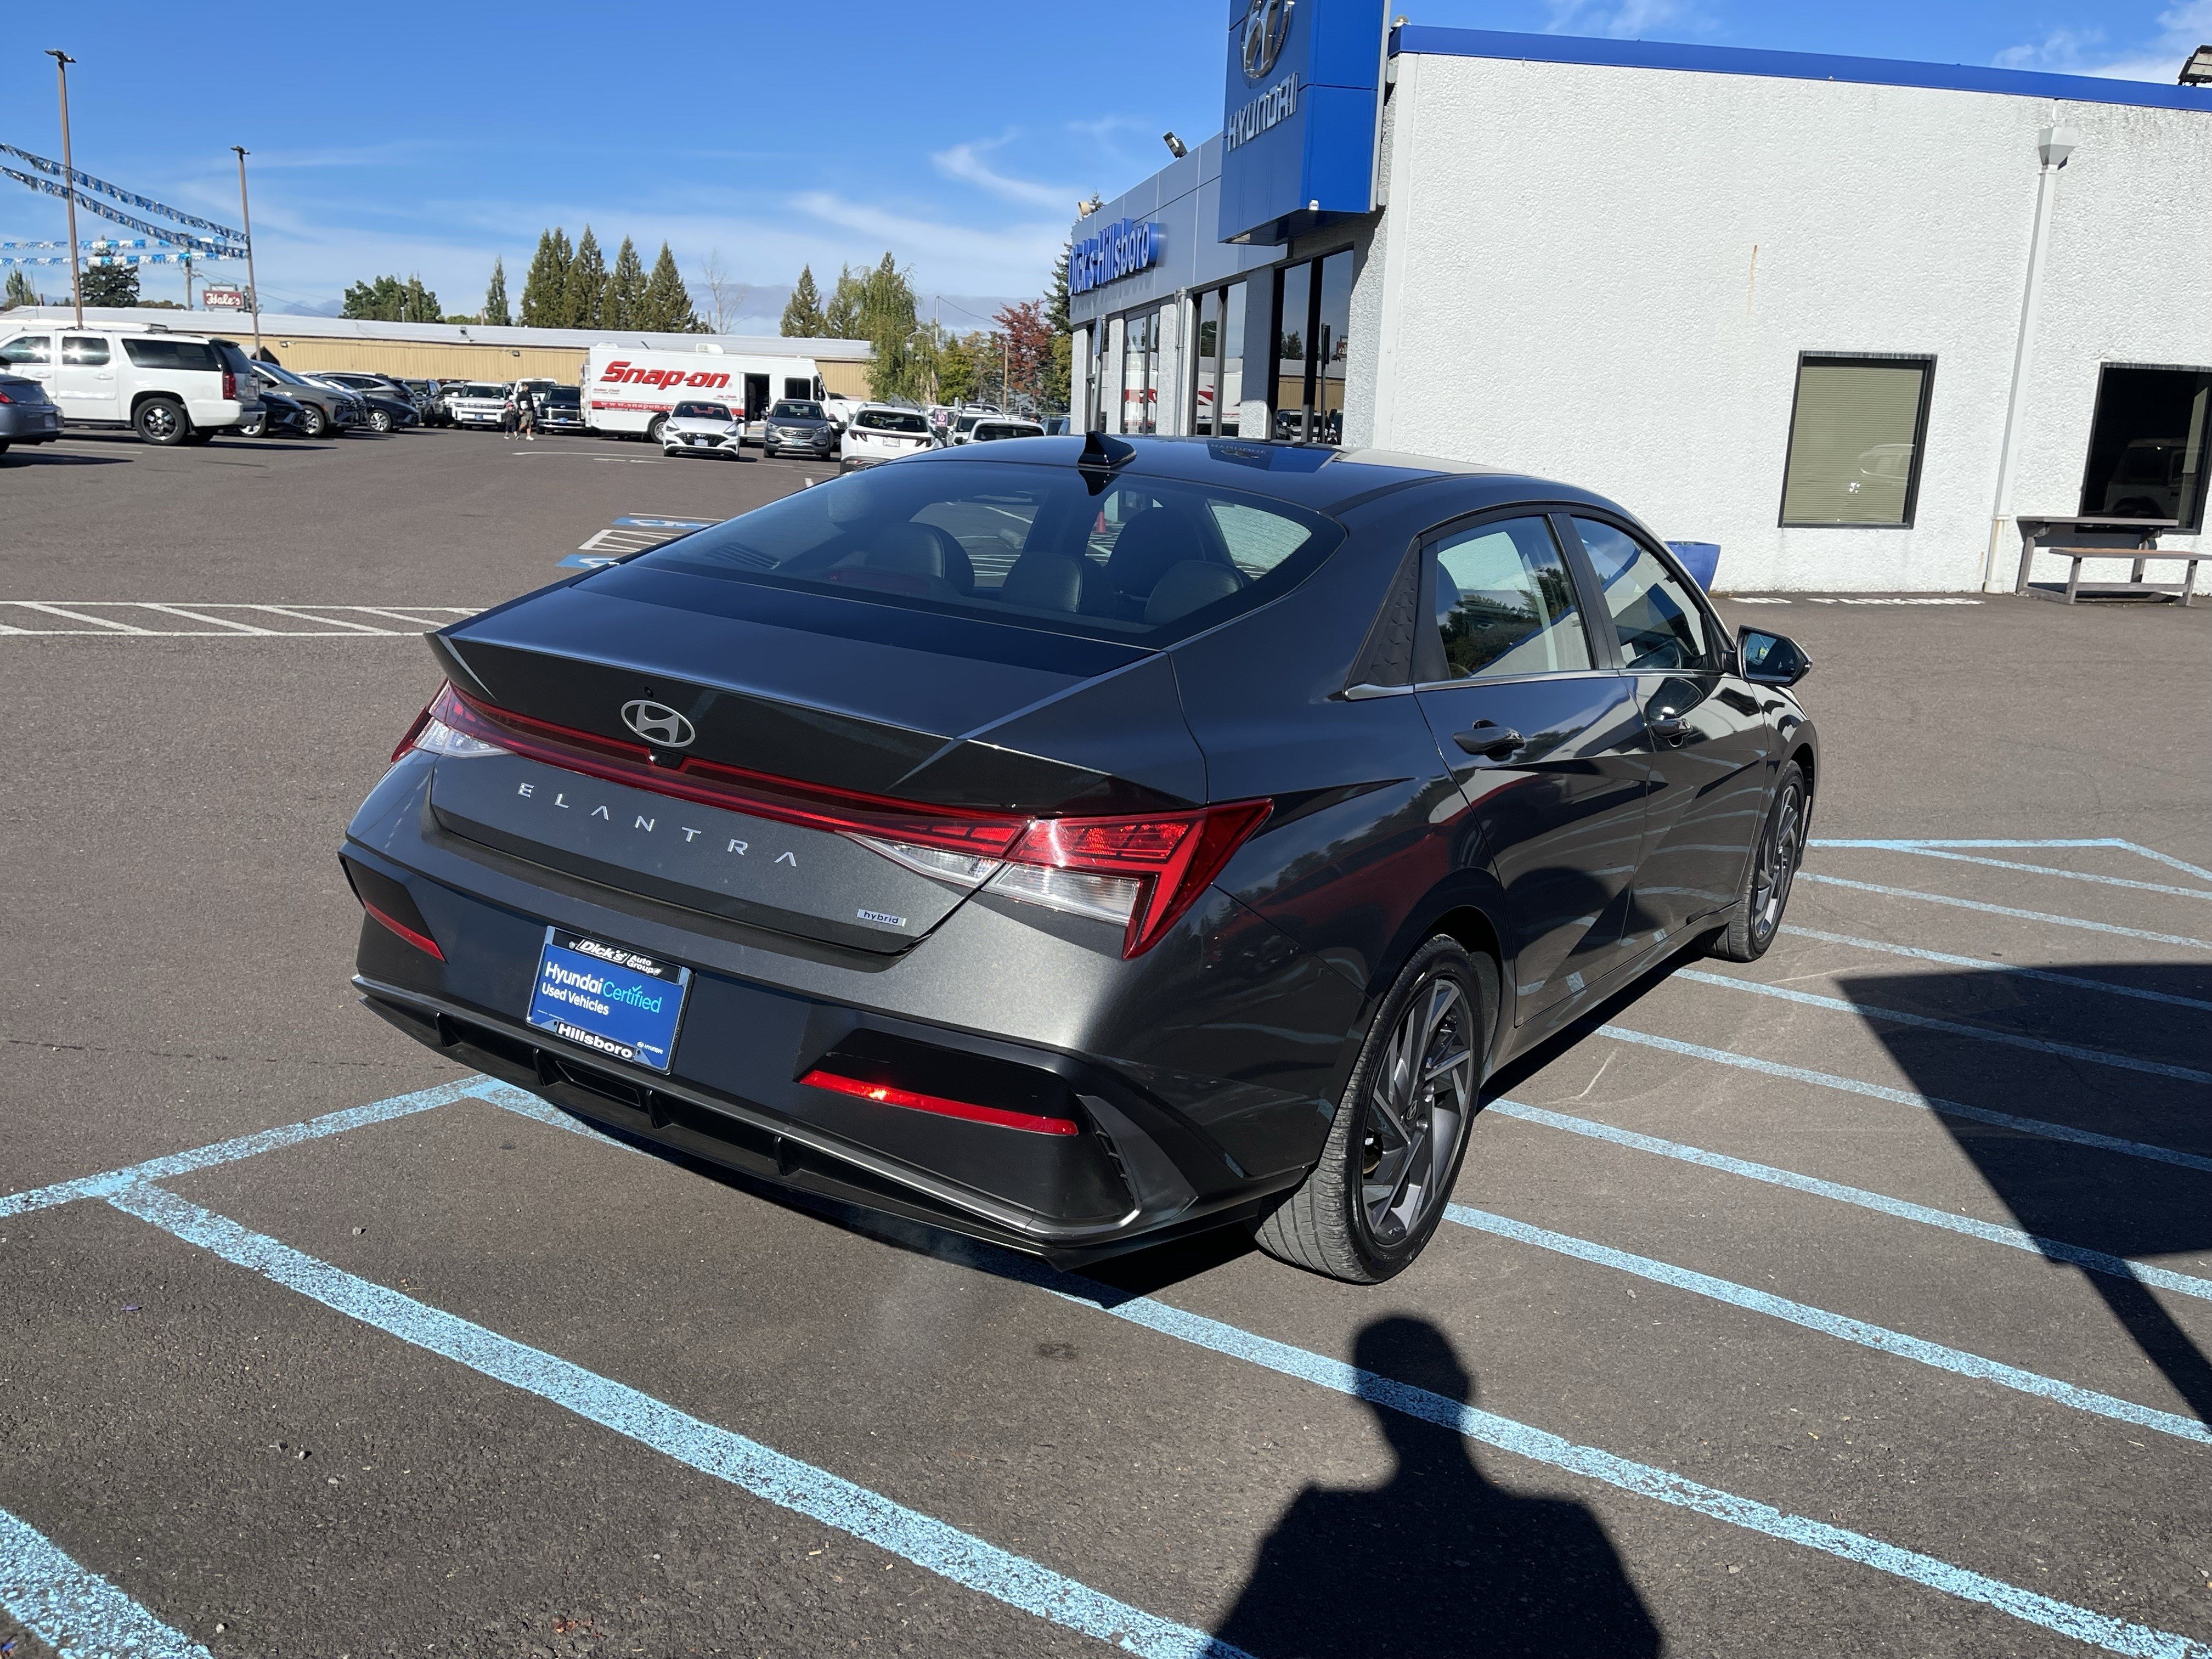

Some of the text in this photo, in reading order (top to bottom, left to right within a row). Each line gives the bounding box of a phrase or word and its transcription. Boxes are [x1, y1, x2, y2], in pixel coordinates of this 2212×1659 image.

[1228, 72, 1299, 152] HYUNDAI
[1097, 218, 1151, 285] Hillsboro
[206, 293, 241, 306] Hale's
[600, 361, 731, 390] Snap-on
[517, 782, 797, 867] ELANTRA
[864, 911, 899, 924] hybrid
[579, 941, 628, 961] Dick's
[629, 955, 652, 966] Auto
[627, 960, 654, 974] Group
[541, 982, 566, 1002] Used
[567, 990, 610, 1016] Vehicles
[545, 961, 662, 1013] Hyundai Certified
[557, 1023, 633, 1058] Hillsboro
